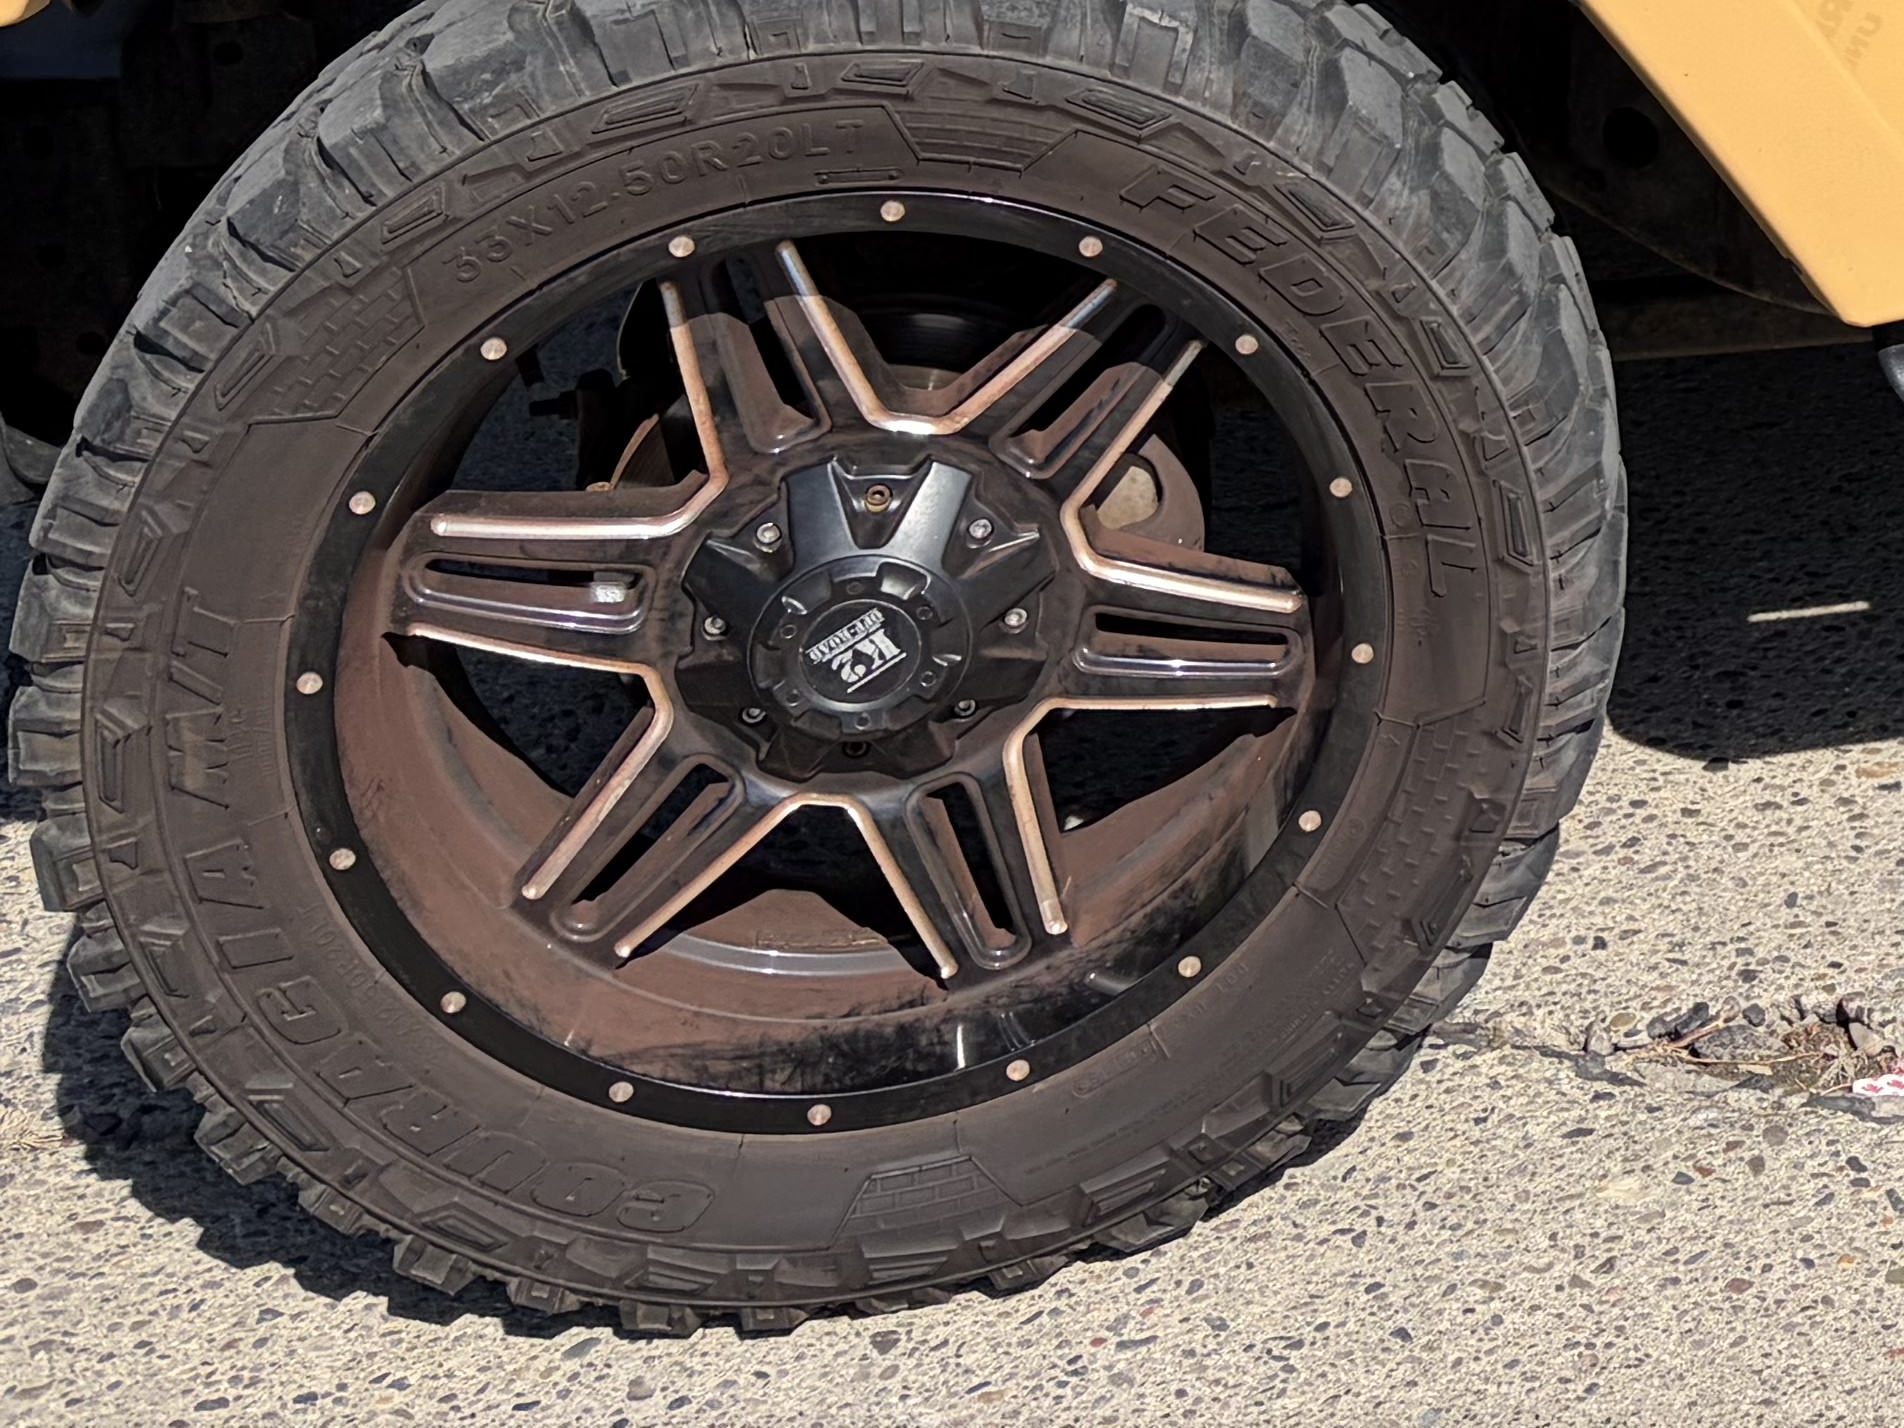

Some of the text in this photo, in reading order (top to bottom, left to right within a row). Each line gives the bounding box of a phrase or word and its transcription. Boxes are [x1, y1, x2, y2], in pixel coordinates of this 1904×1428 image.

[1118, 164, 1480, 599] FEDERAL
[831, 628, 902, 682] K2
[184, 841, 716, 1232] COURAGIA
